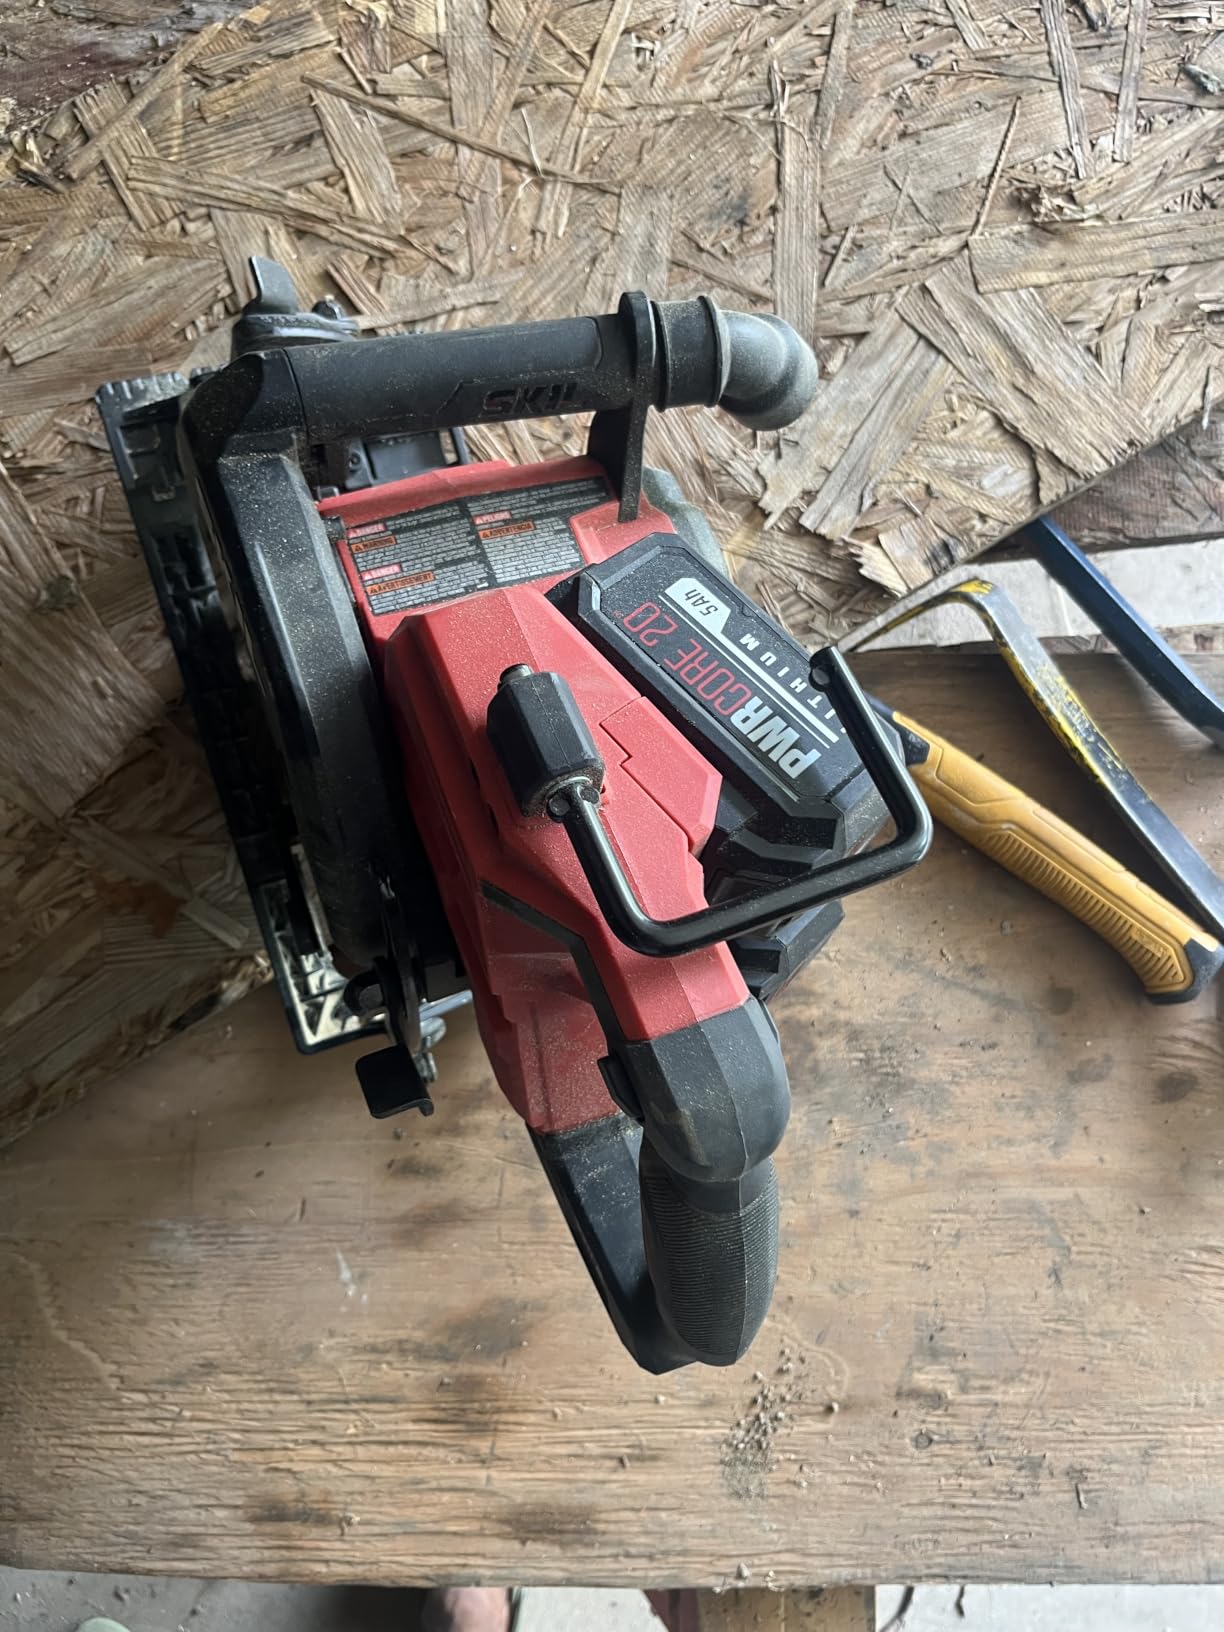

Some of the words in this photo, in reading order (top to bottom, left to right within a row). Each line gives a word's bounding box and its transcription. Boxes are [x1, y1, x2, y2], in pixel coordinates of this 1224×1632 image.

[483, 382, 580, 413] SKIL
[377, 572, 432, 591] AVERTISSEMENT
[623, 601, 678, 647] 20
[739, 632, 847, 734] ITHIUM
